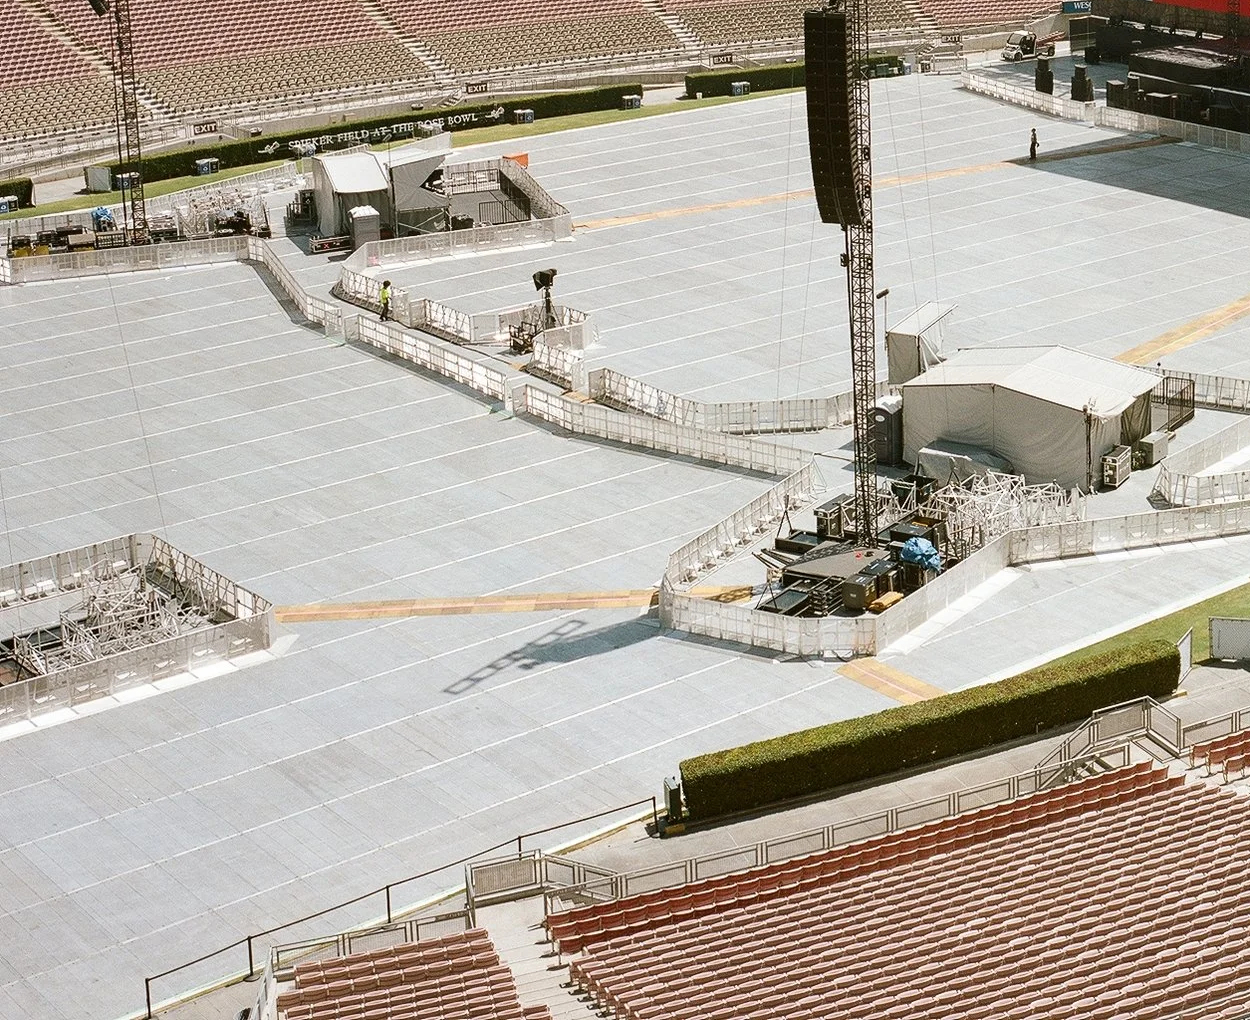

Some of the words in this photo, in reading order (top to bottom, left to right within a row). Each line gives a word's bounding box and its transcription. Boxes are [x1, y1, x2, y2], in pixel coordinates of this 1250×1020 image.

[713, 55, 732, 64] EXIT
[467, 84, 487, 93] EXIT
[194, 123, 216, 134] EXIT
[336, 129, 370, 142] FIELD
[373, 126, 388, 137] AT
[391, 122, 414, 134] THE
[447, 113, 478, 125] BOWL
